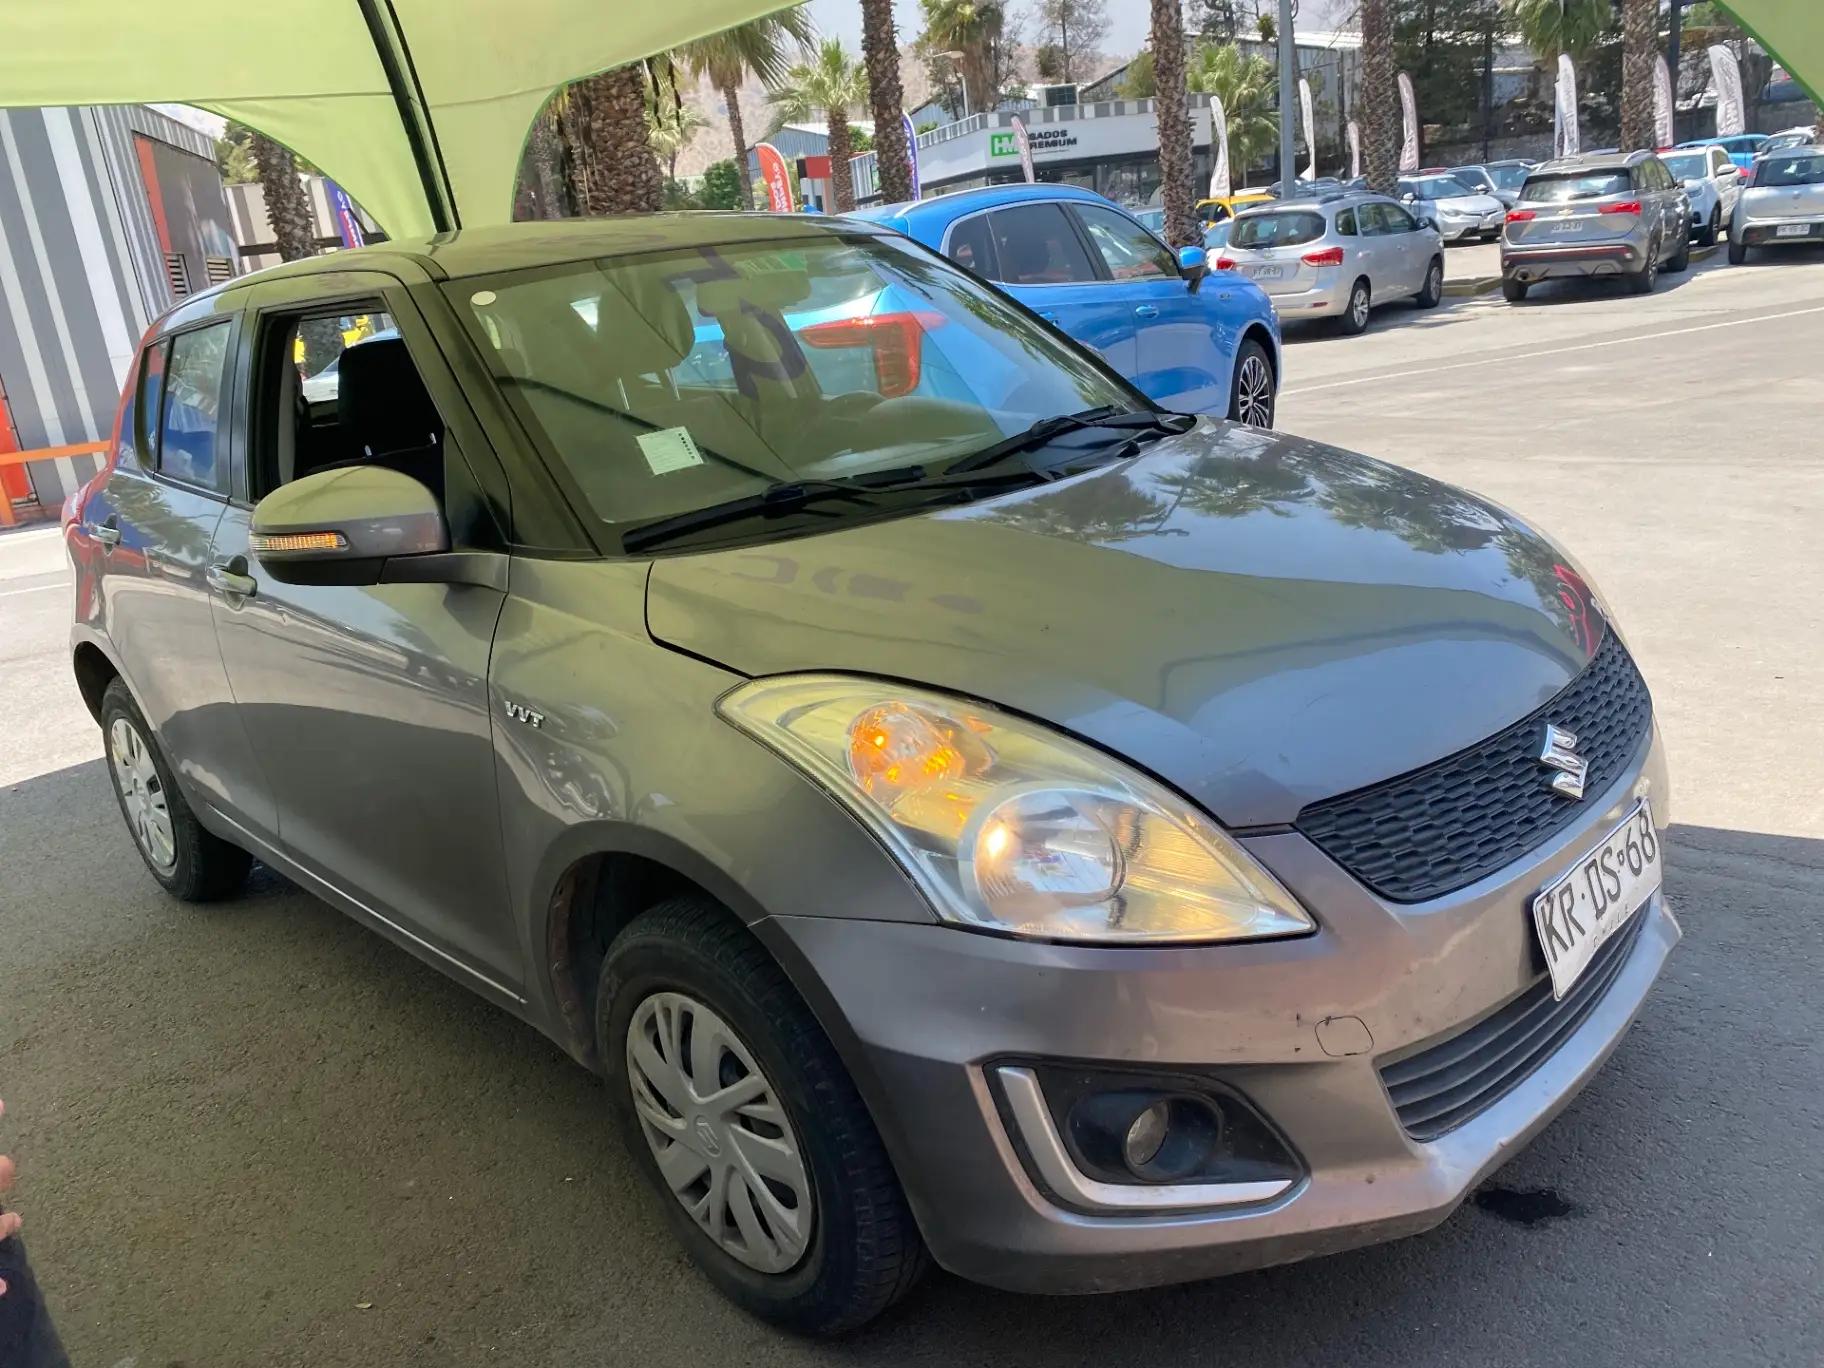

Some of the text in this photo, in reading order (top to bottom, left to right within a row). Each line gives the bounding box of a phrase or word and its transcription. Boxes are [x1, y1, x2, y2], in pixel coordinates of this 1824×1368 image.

[1028, 129, 1068, 141] SADOS
[1029, 137, 1077, 150] REMIUM
[504, 700, 545, 728] VVT
